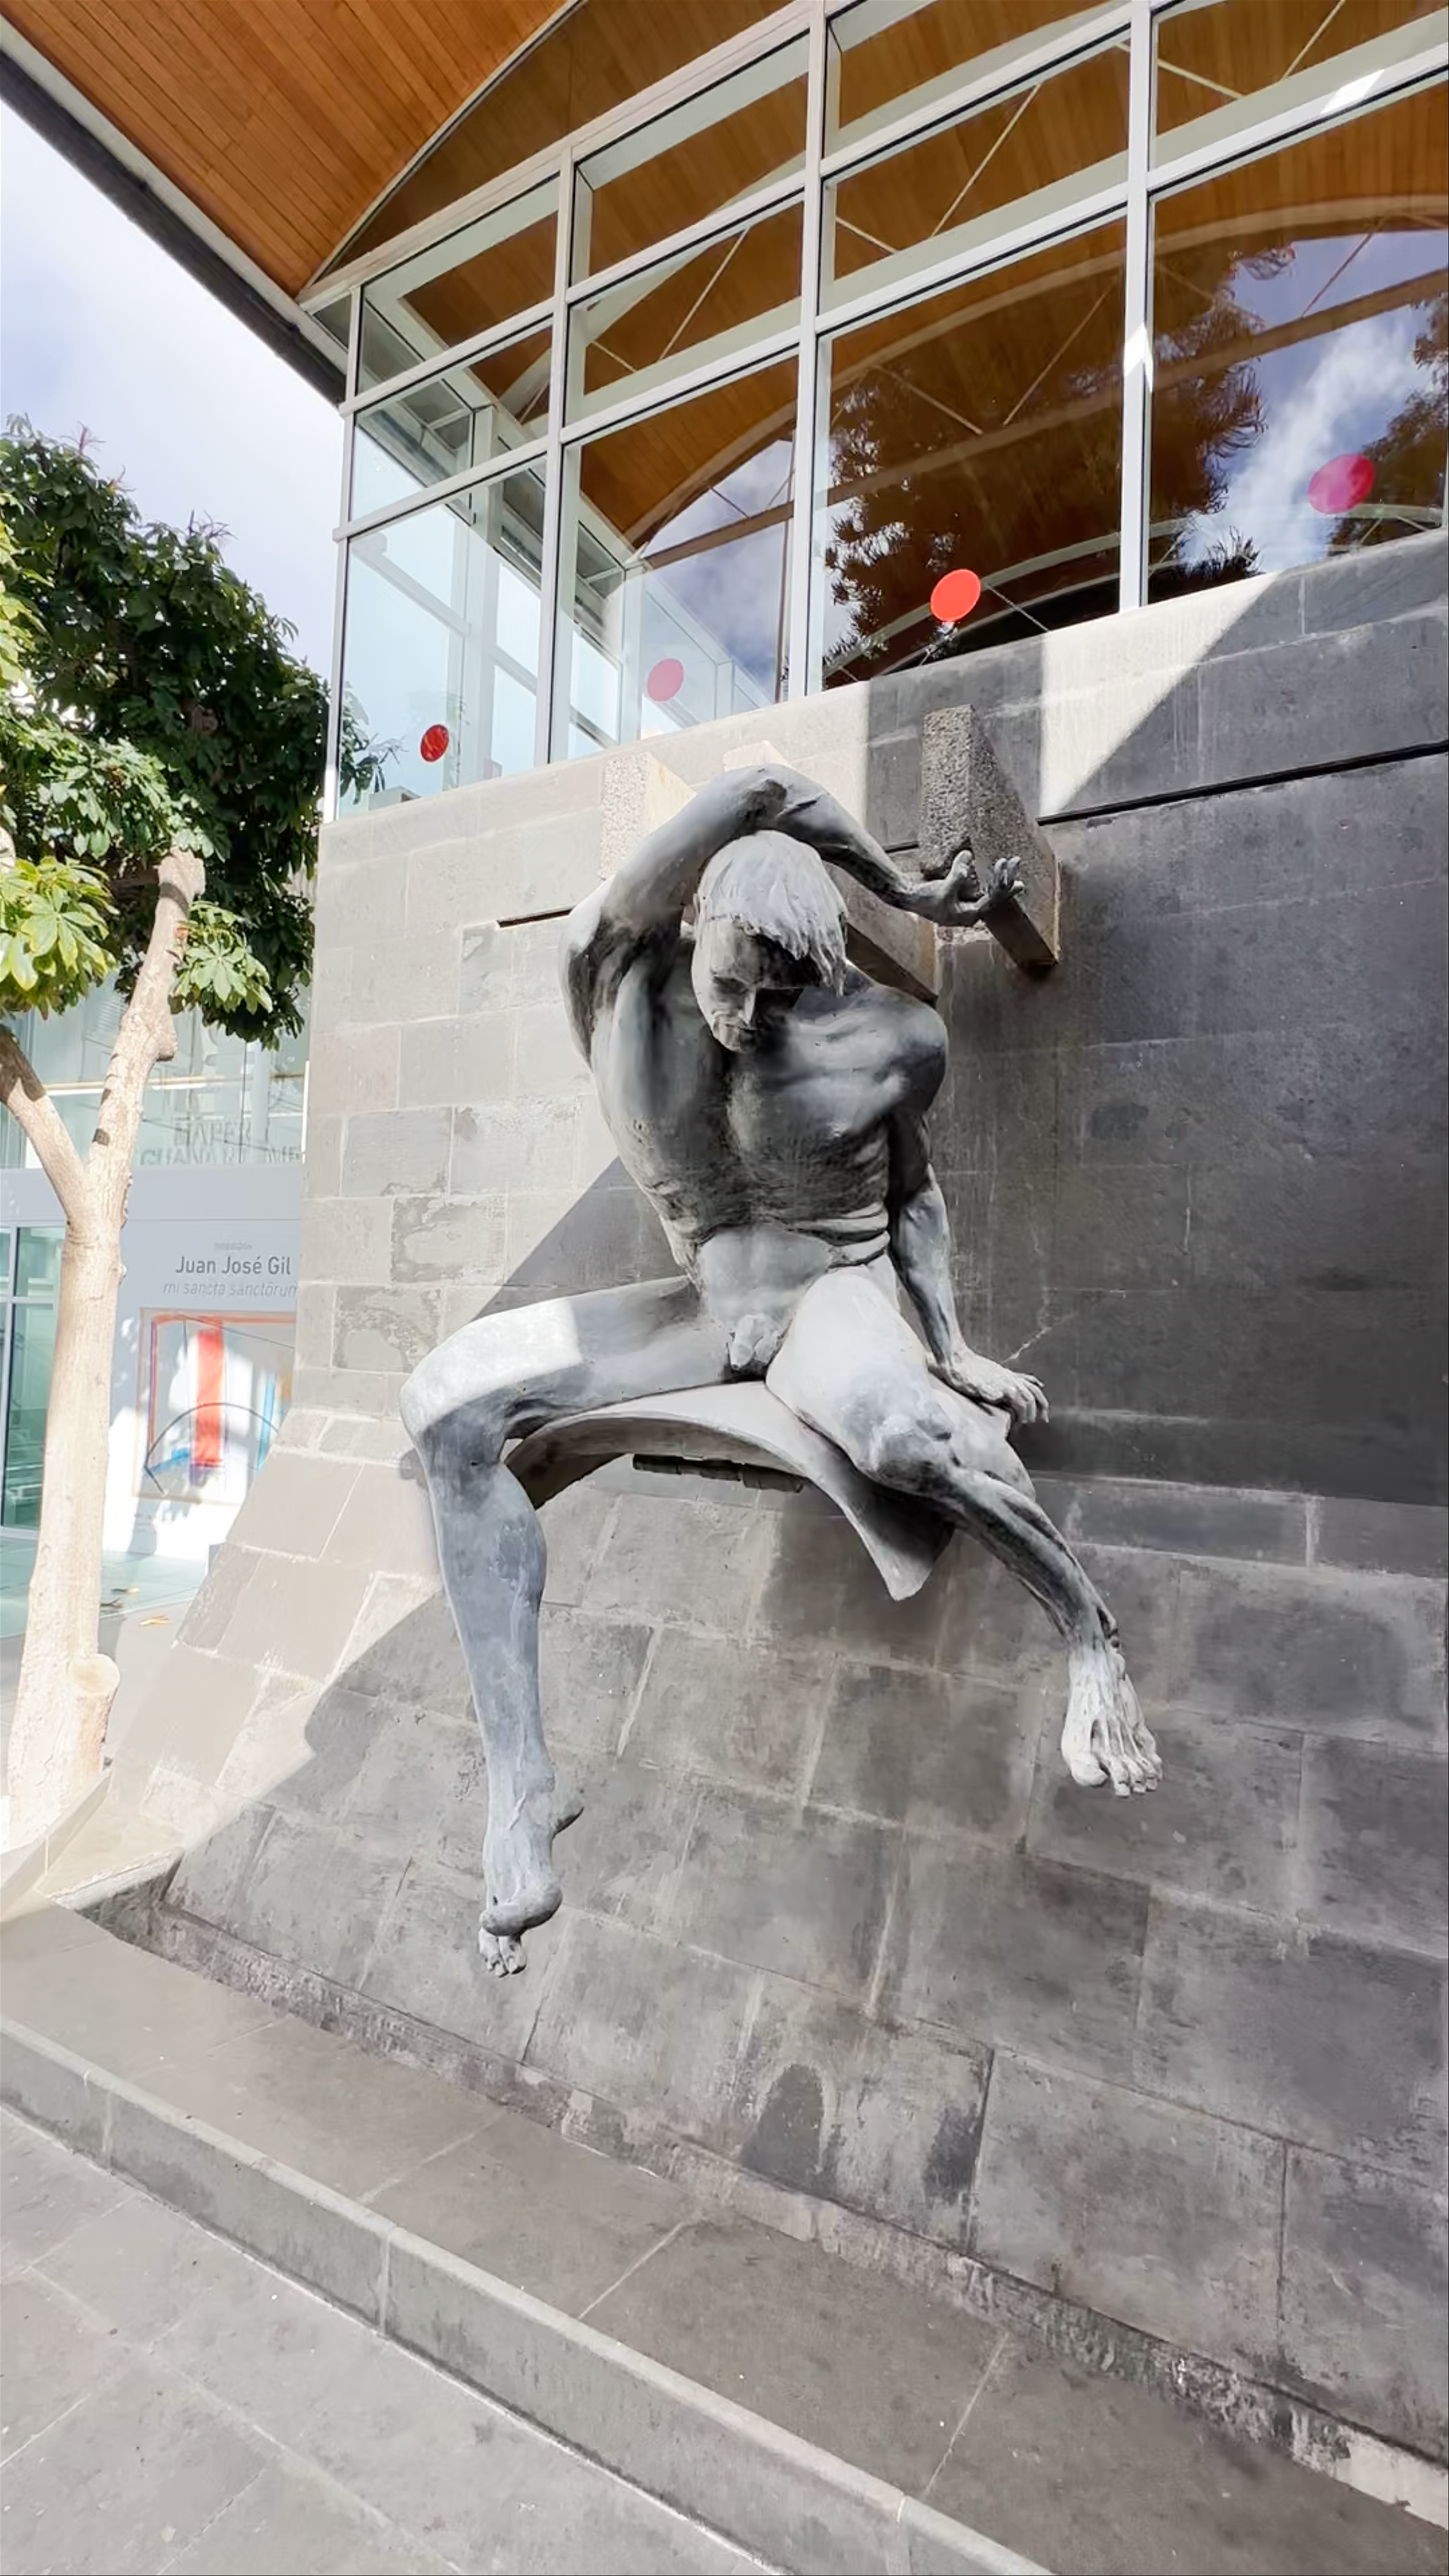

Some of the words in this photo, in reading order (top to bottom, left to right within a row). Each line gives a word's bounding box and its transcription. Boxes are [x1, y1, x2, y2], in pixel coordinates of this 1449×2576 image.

[175, 1255, 216, 1273] Juan
[221, 1255, 262, 1275] José
[268, 1256, 291, 1275] Gil
